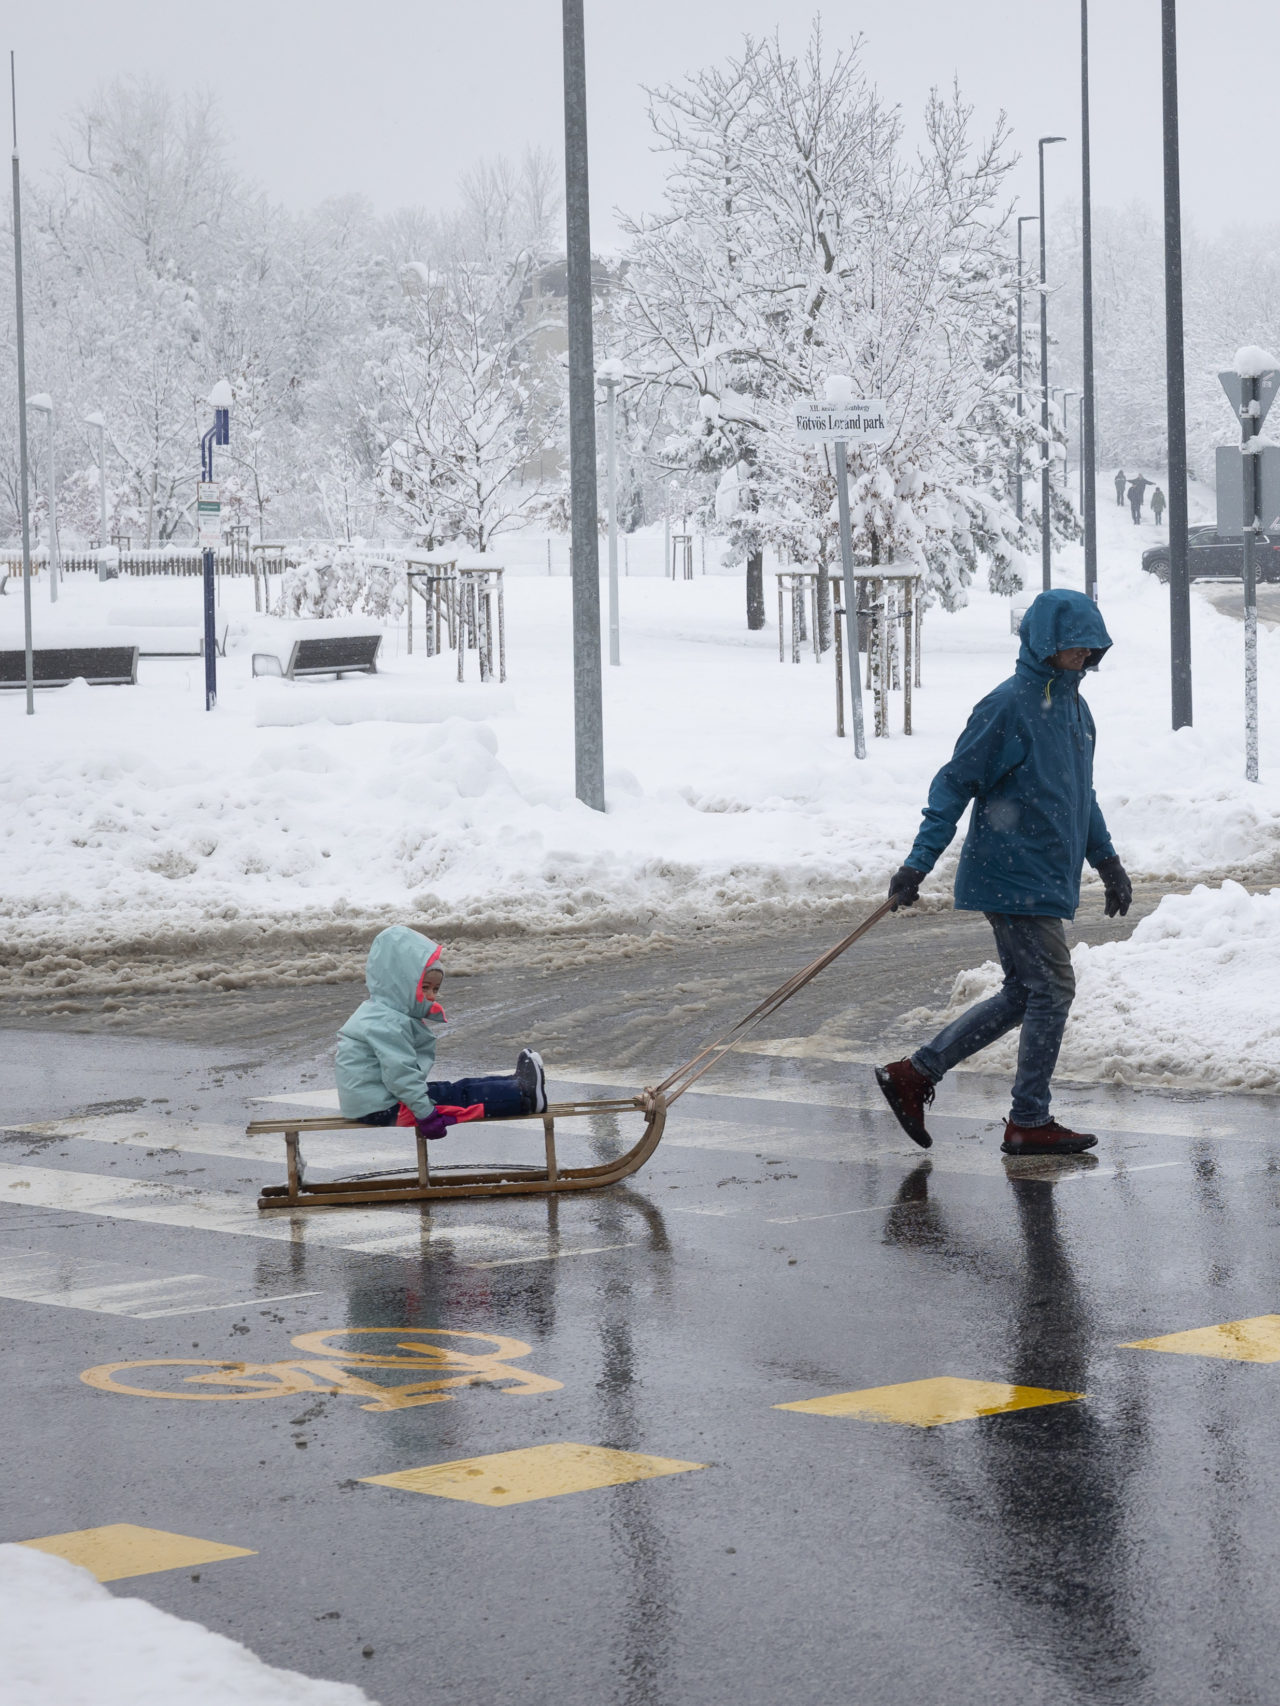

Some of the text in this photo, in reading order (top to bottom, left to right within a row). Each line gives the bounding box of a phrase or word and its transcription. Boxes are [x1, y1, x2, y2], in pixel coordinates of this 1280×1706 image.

[796, 414, 885, 432] Eötvös Loránd park
